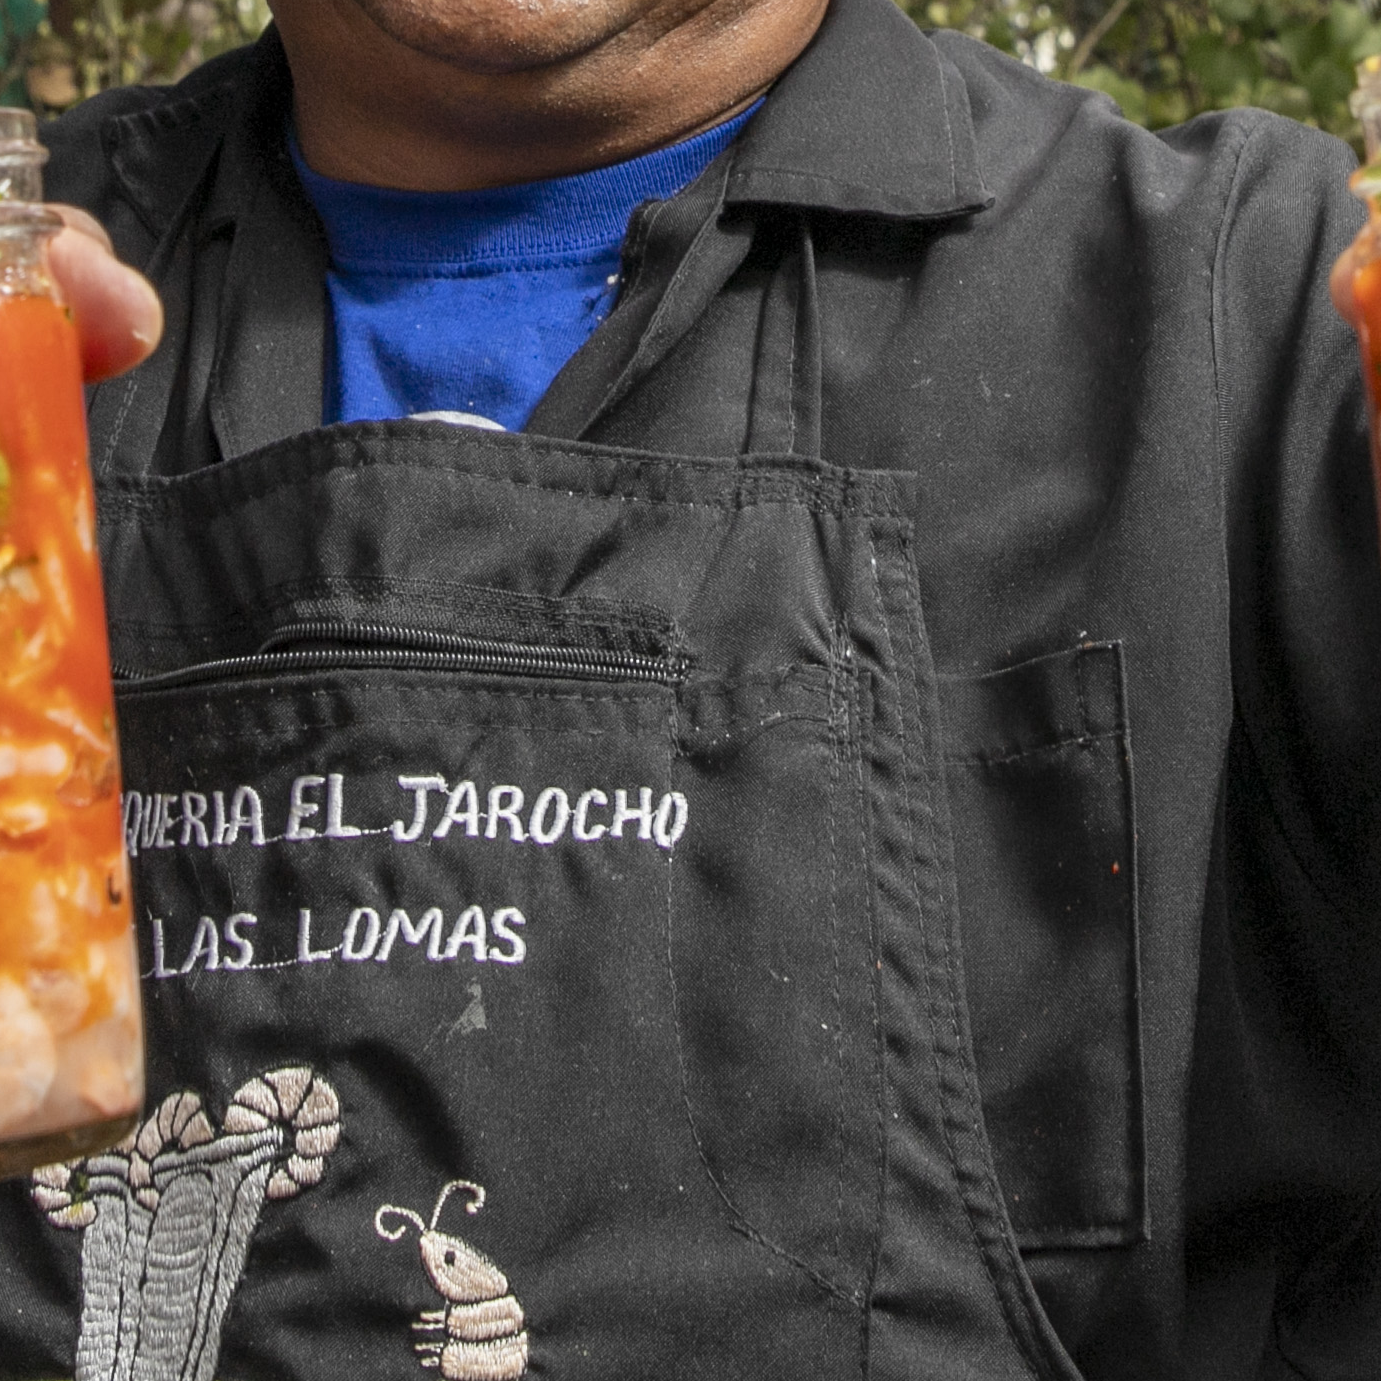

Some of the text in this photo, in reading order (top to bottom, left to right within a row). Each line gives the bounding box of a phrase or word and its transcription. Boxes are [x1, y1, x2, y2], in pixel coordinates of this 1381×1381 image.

[119, 773, 688, 857] QUERIA EL JAROCHO
[152, 905, 527, 978] LAS LOMAS
